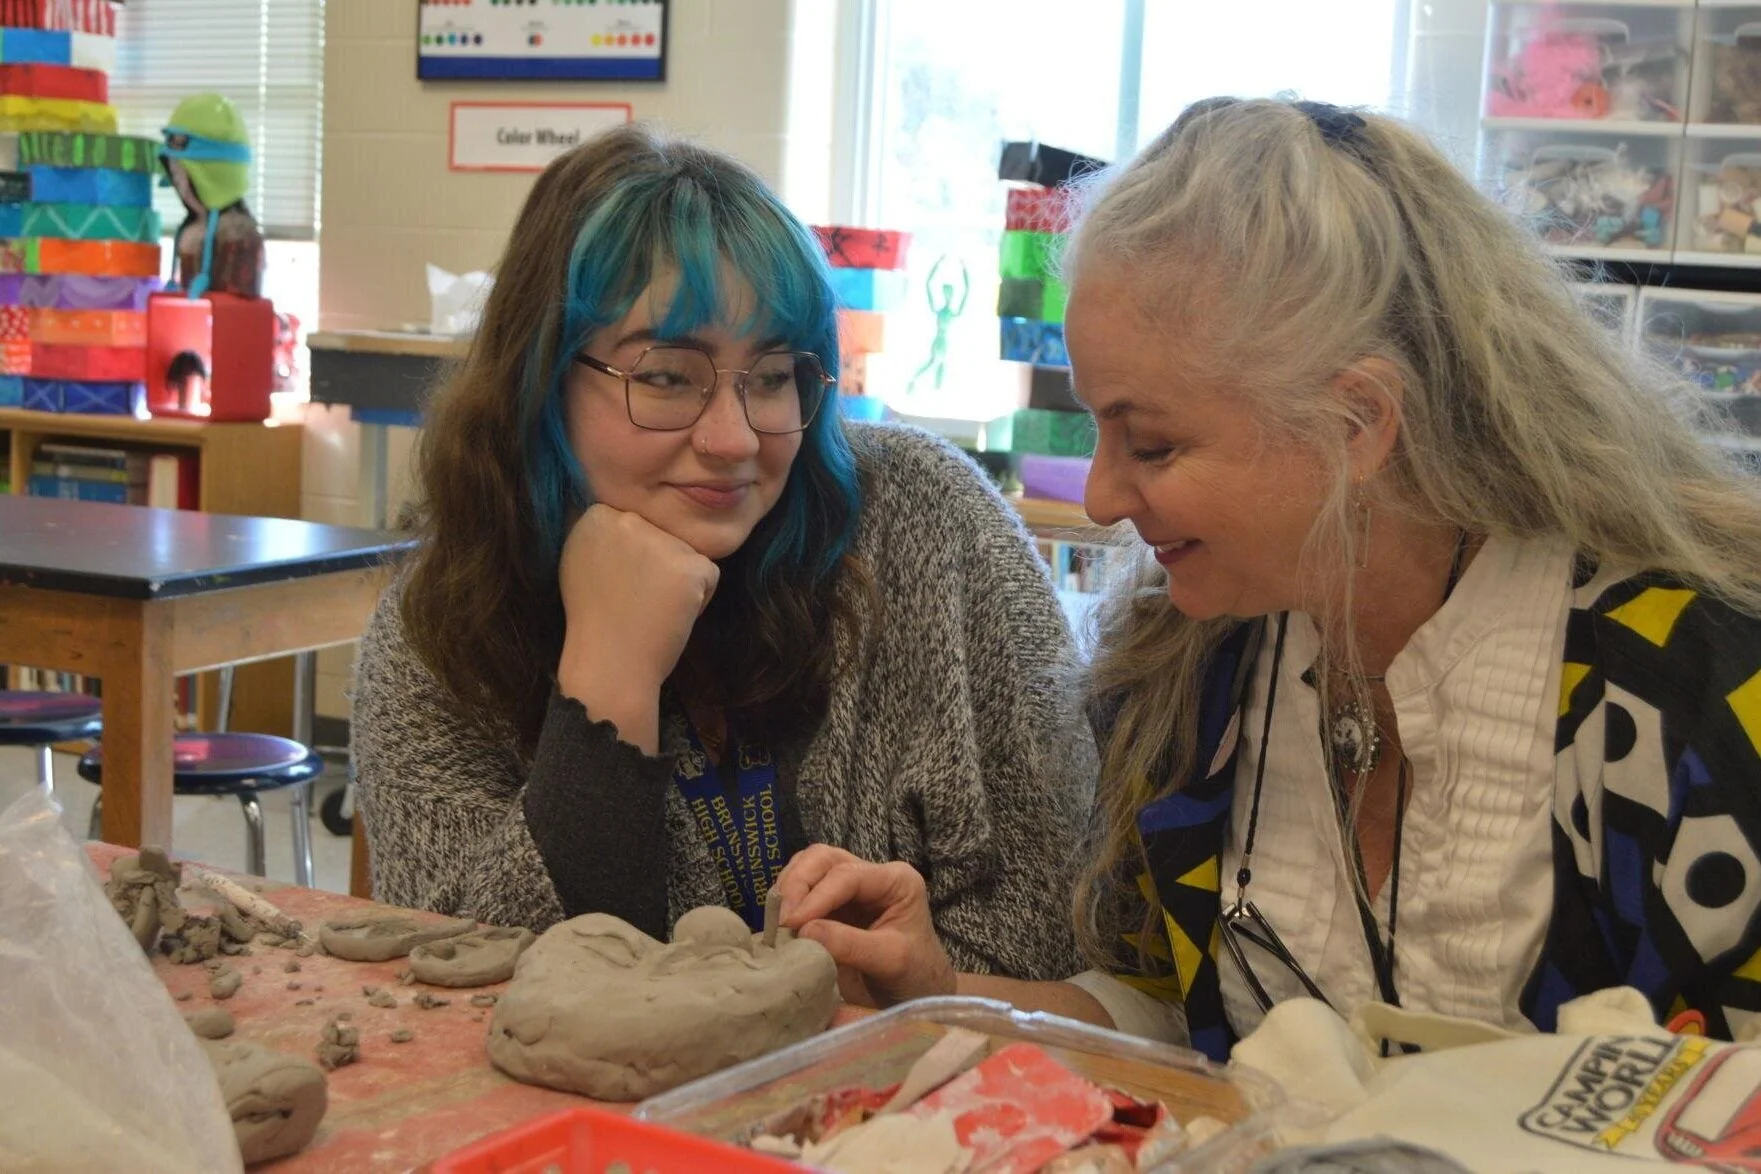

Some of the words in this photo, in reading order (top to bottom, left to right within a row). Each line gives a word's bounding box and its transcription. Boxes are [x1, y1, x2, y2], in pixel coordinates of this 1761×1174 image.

[496, 128, 531, 145] Color
[536, 128, 580, 145] Wheel
[691, 797, 720, 844] HIGH
[742, 793, 769, 907] BRUNSWICK
[760, 784, 781, 860] SCHOOL
[1536, 1036, 1634, 1128] CAMPIN
